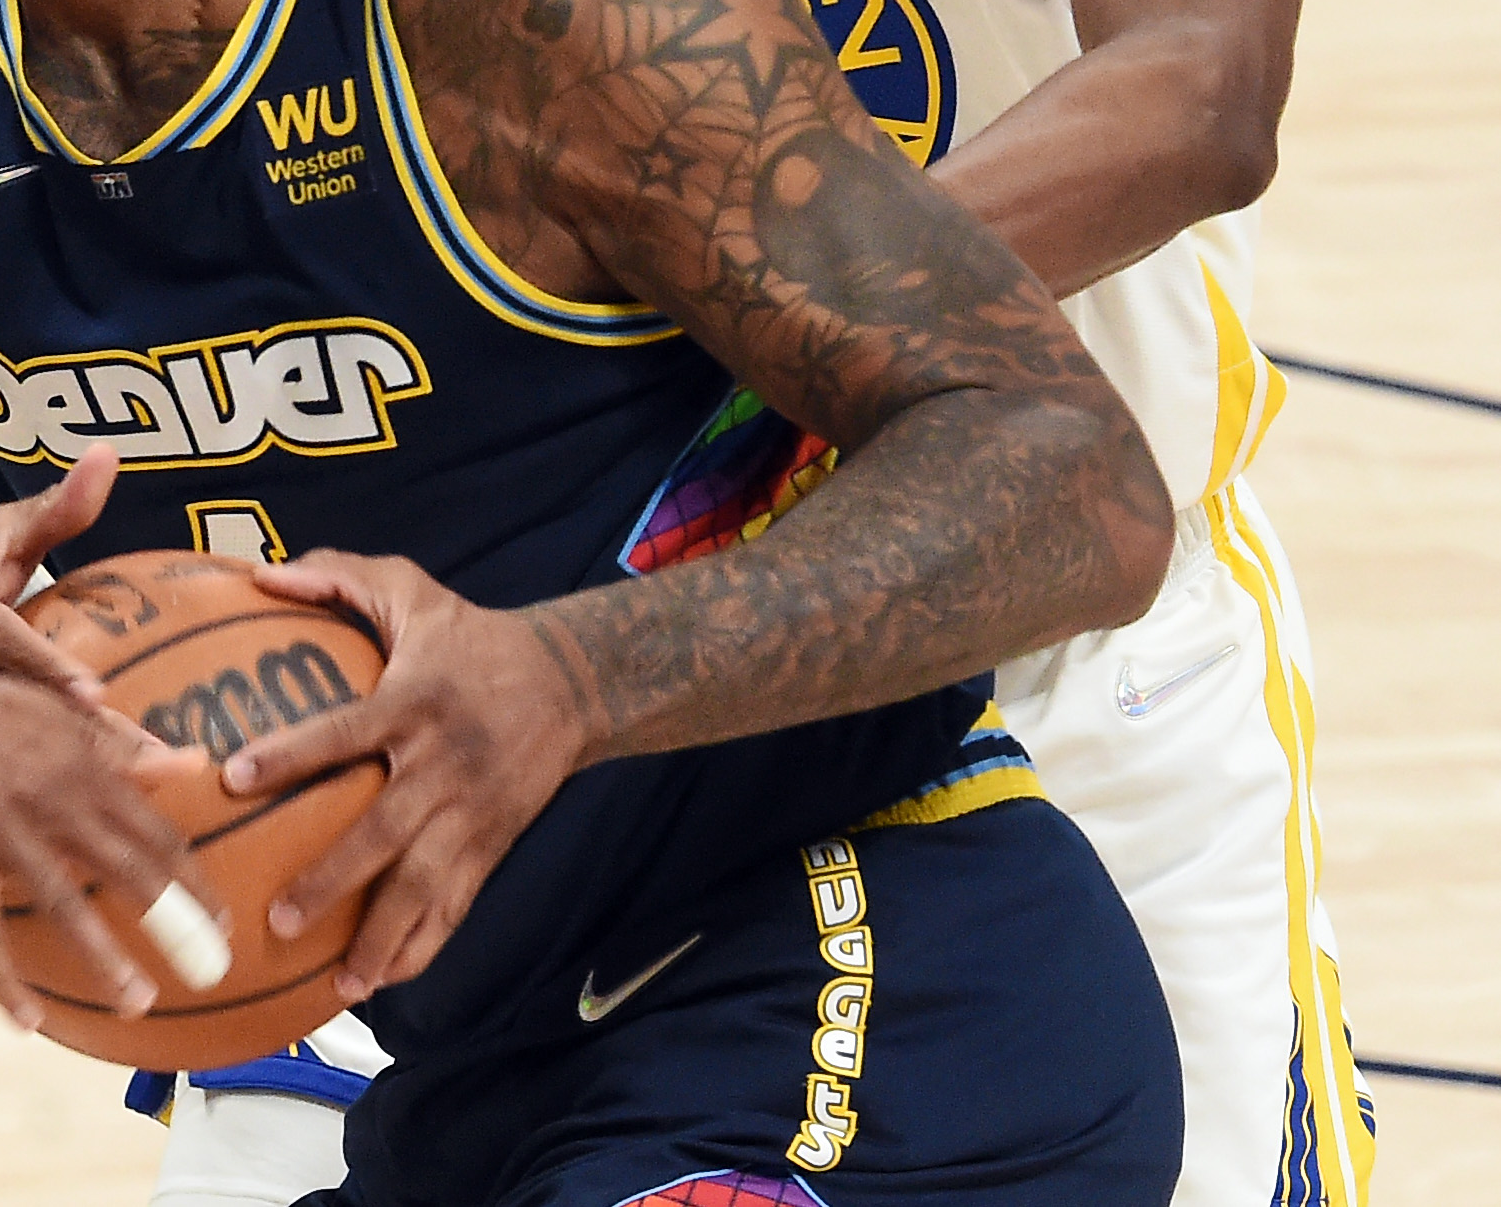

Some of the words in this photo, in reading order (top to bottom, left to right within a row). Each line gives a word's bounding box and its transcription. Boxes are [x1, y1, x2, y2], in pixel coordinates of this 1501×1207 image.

[256, 78, 358, 151] WU
[265, 144, 366, 184] Western
[287, 173, 357, 205] Union
